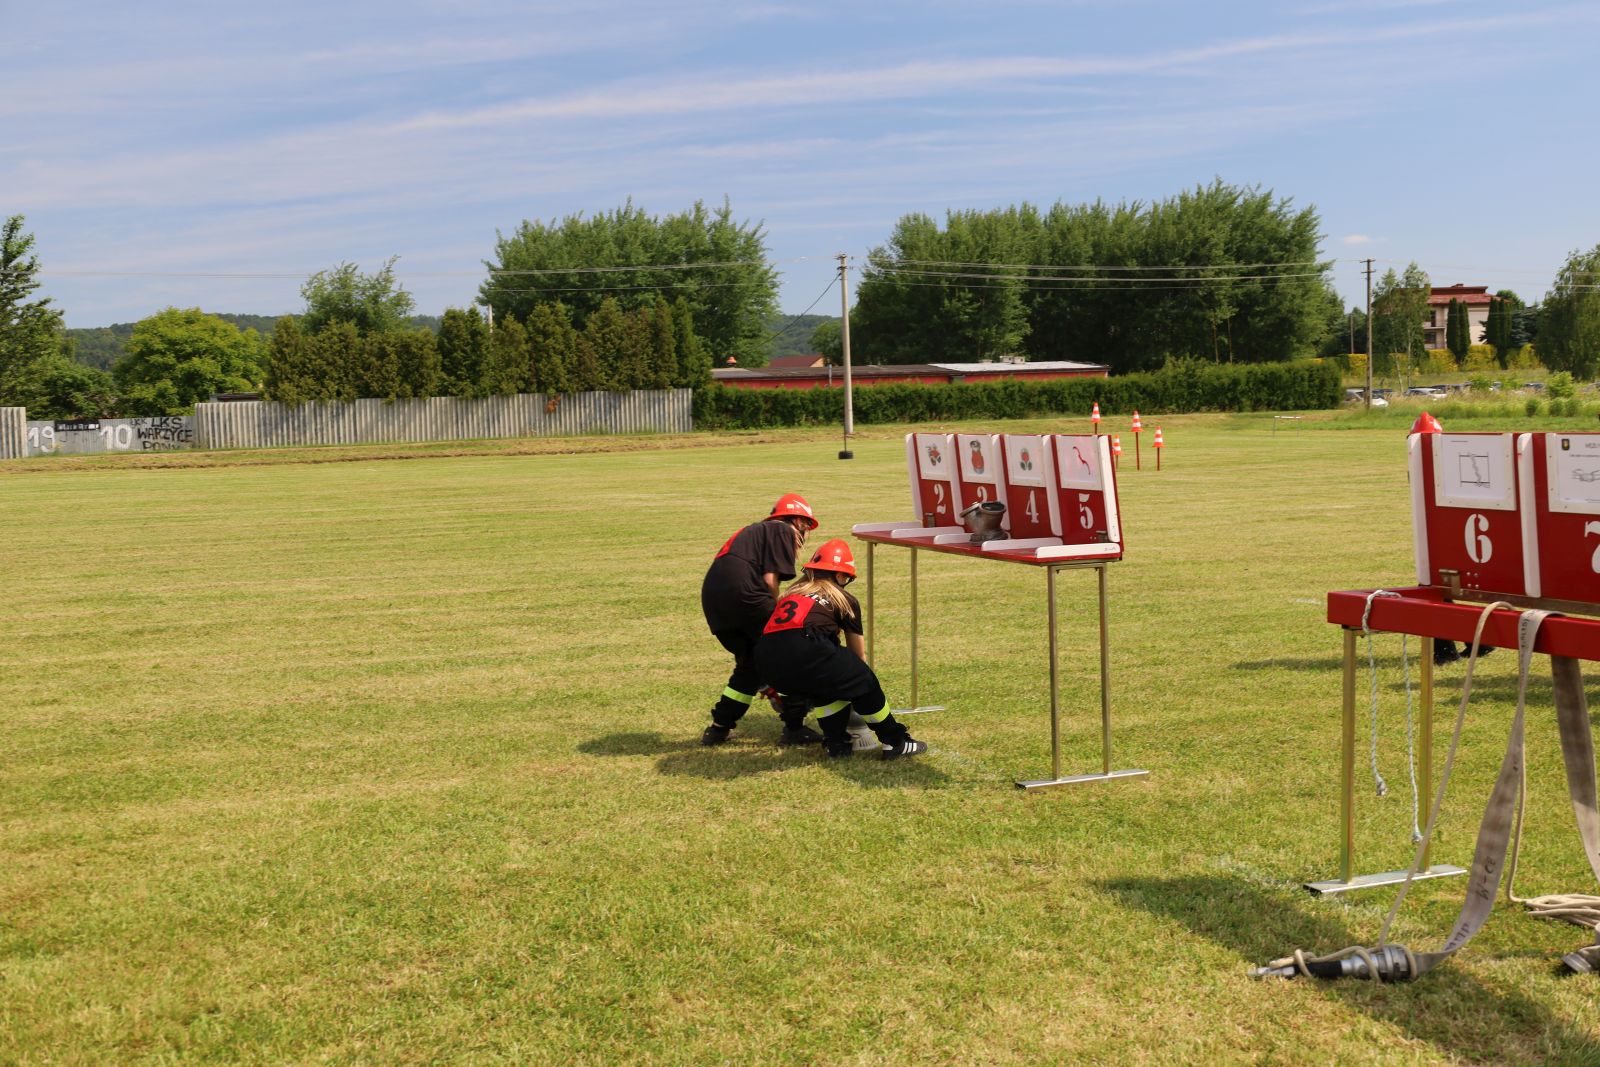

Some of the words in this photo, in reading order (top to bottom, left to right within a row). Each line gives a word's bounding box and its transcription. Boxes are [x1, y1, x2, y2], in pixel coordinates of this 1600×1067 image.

[151, 417, 182, 429] LKS
[28, 425, 55, 454] 19
[100, 424, 133, 451] 10
[934, 484, 946, 514] 2
[1026, 490, 1039, 524] 4
[1079, 493, 1094, 529] 5
[1464, 513, 1493, 564] 6
[775, 600, 798, 624] 3
